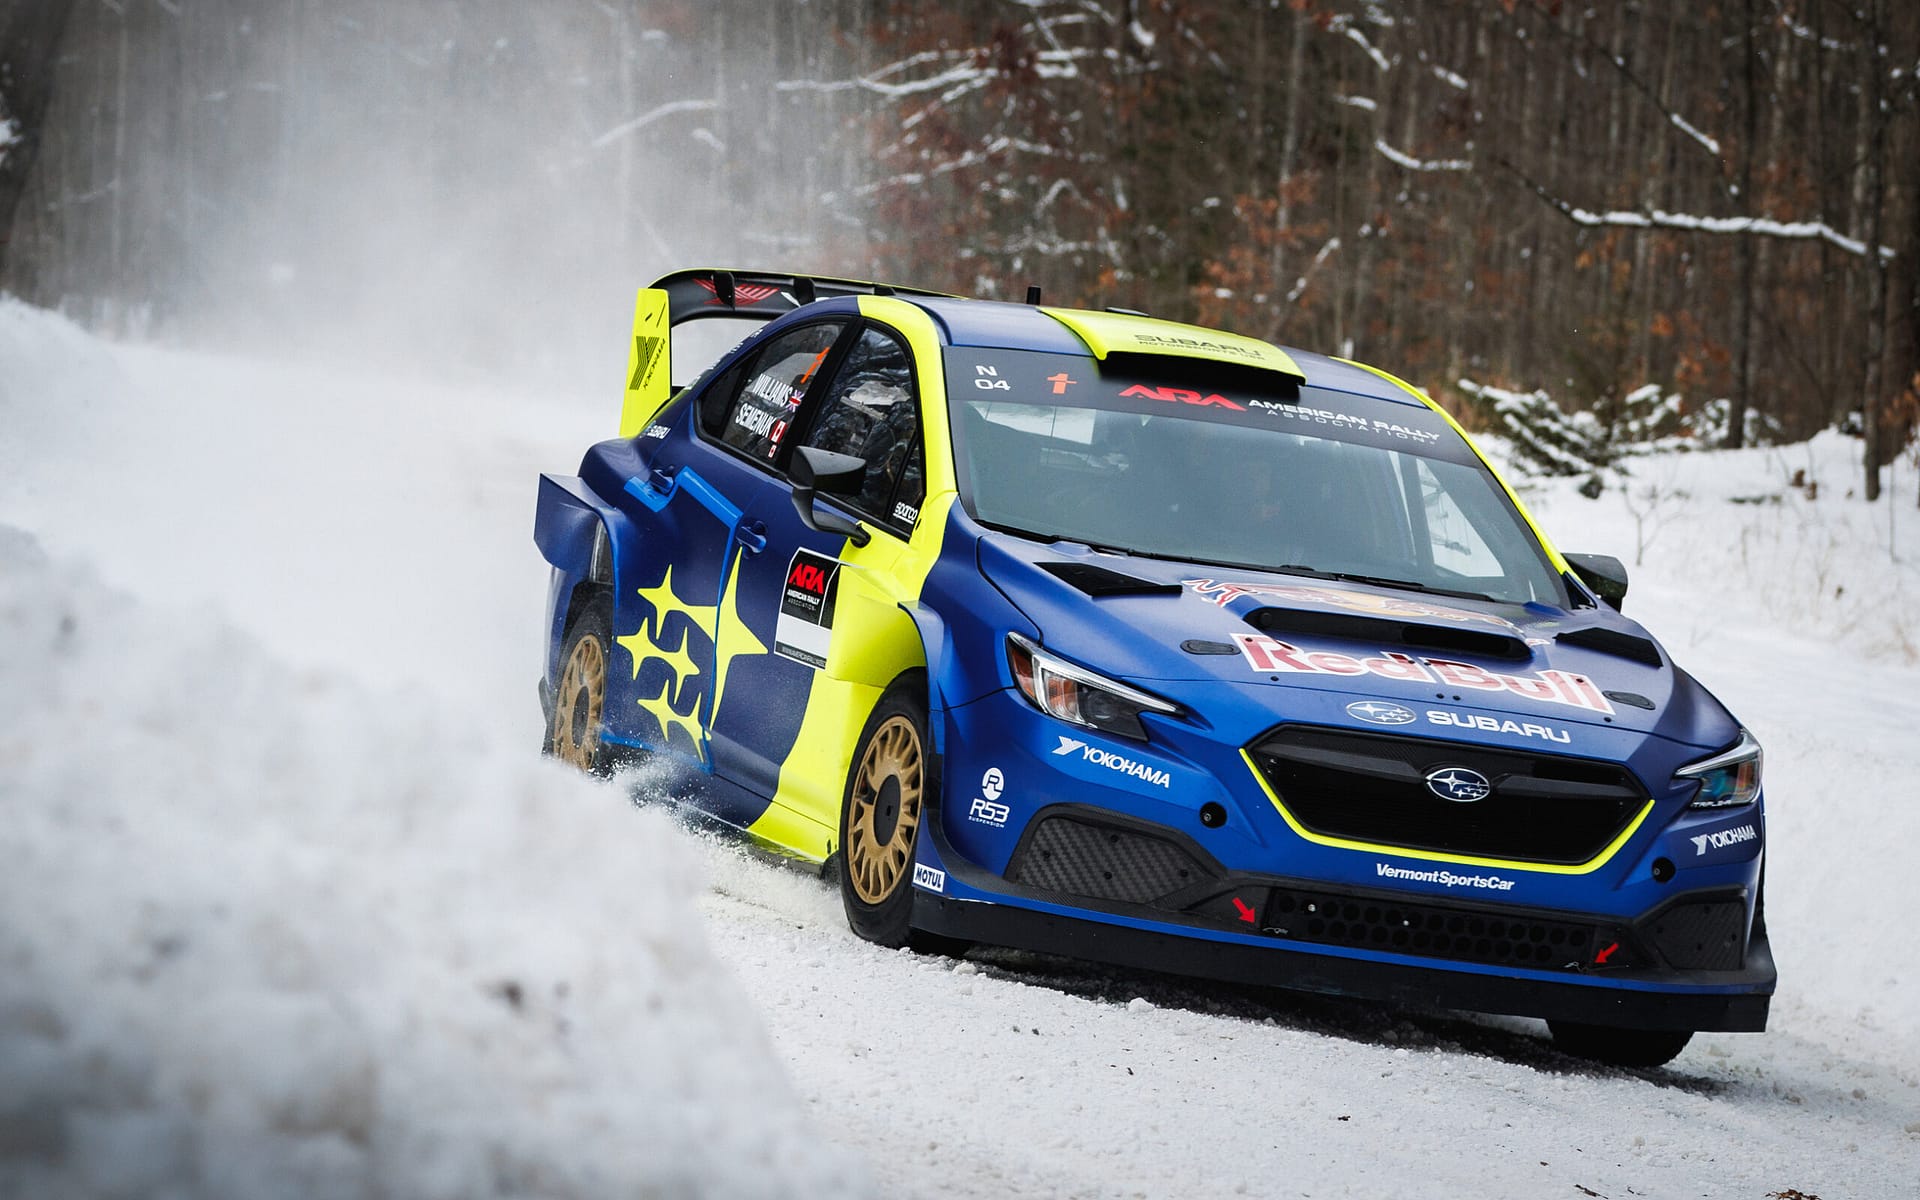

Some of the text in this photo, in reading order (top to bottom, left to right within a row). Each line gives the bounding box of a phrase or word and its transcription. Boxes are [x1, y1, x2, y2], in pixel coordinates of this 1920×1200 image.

[1134, 334, 1262, 357] SUBARU
[974, 379, 1011, 391] 04
[975, 365, 998, 377] N
[752, 373, 793, 408] WILLIAMS
[1118, 384, 1248, 412] ARA
[735, 402, 777, 438] SEMENUK
[1249, 399, 1440, 441] AMERICAN RALLY
[1267, 409, 1425, 444] ASSOCIATION
[788, 562, 825, 595] ARA
[1231, 633, 1616, 716] Red Bull
[1426, 709, 1571, 744] SUBARU
[1082, 745, 1171, 789] YOKOHAMA
[969, 798, 1010, 823] R53
[1707, 824, 1757, 849] YOKOHAMA
[915, 866, 942, 889] MOTUL
[1376, 863, 1515, 891] VermontSportsCar
